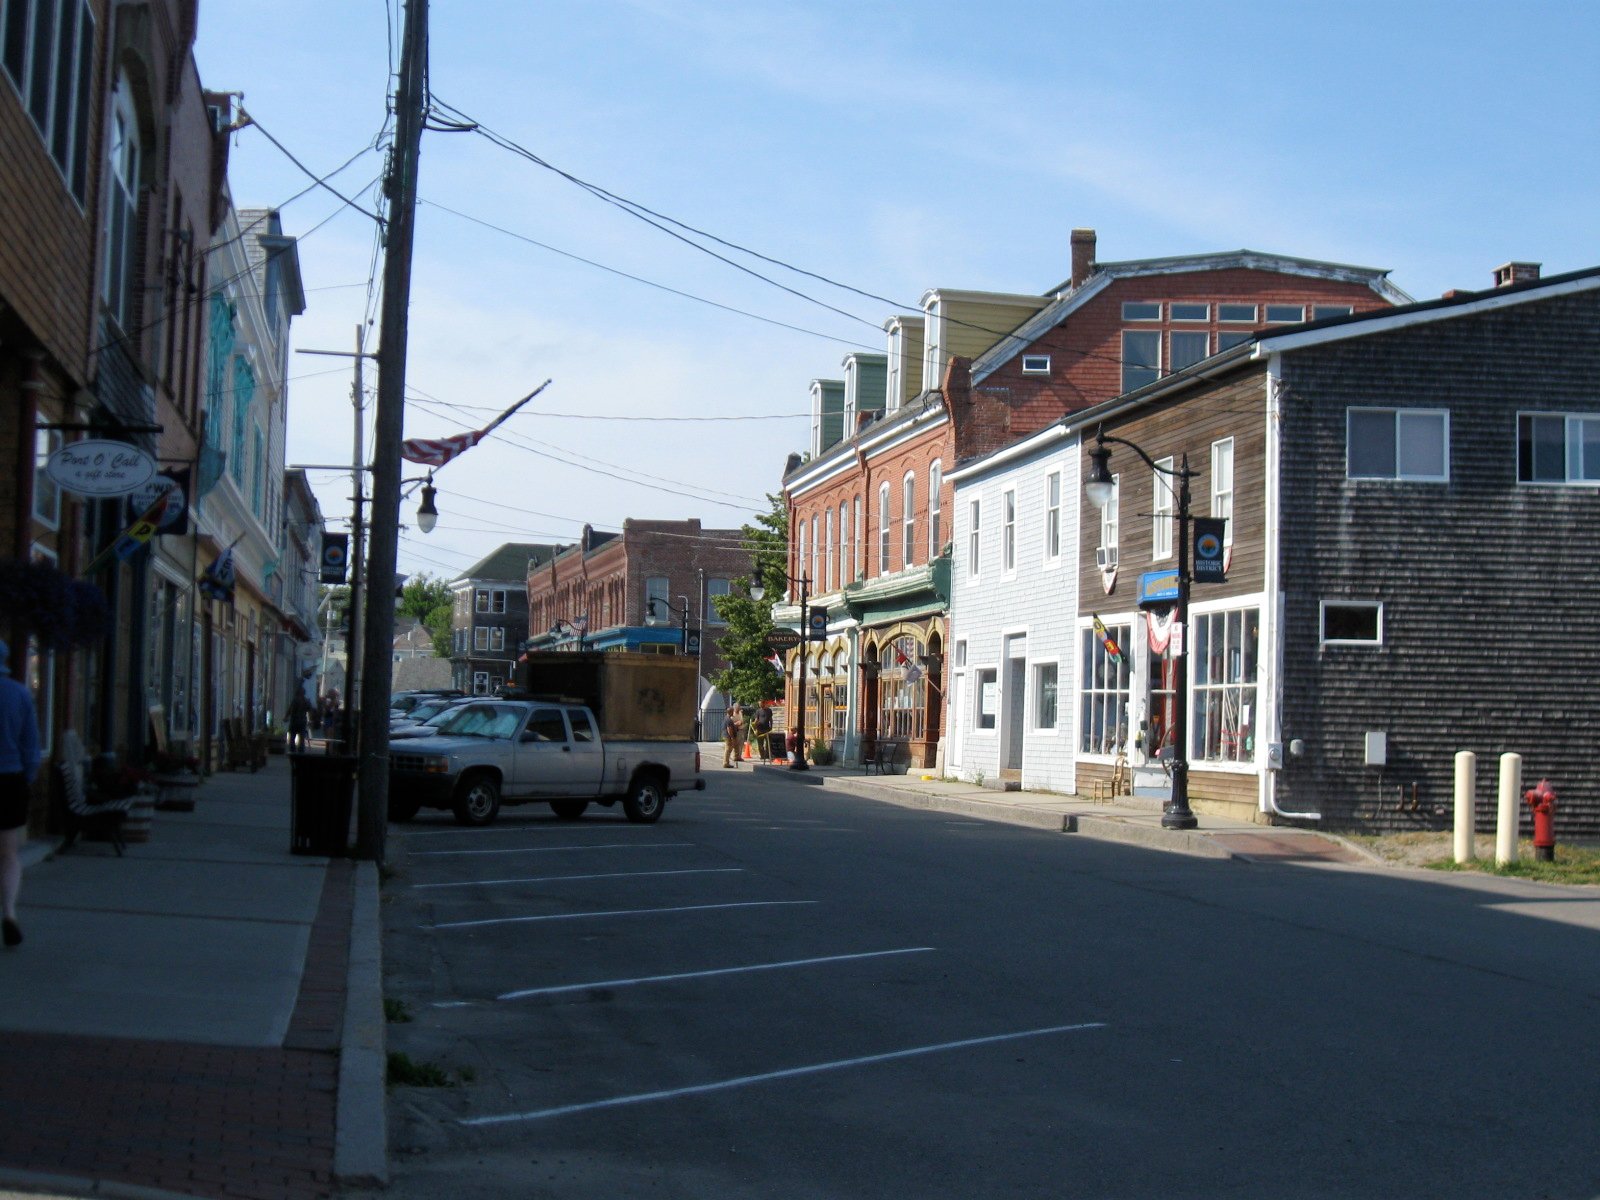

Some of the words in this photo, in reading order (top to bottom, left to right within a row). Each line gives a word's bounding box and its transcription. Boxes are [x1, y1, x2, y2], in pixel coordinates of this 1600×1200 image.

[60, 451, 90, 465] Port
[111, 452, 141, 468] Call
[103, 470, 126, 478] store
